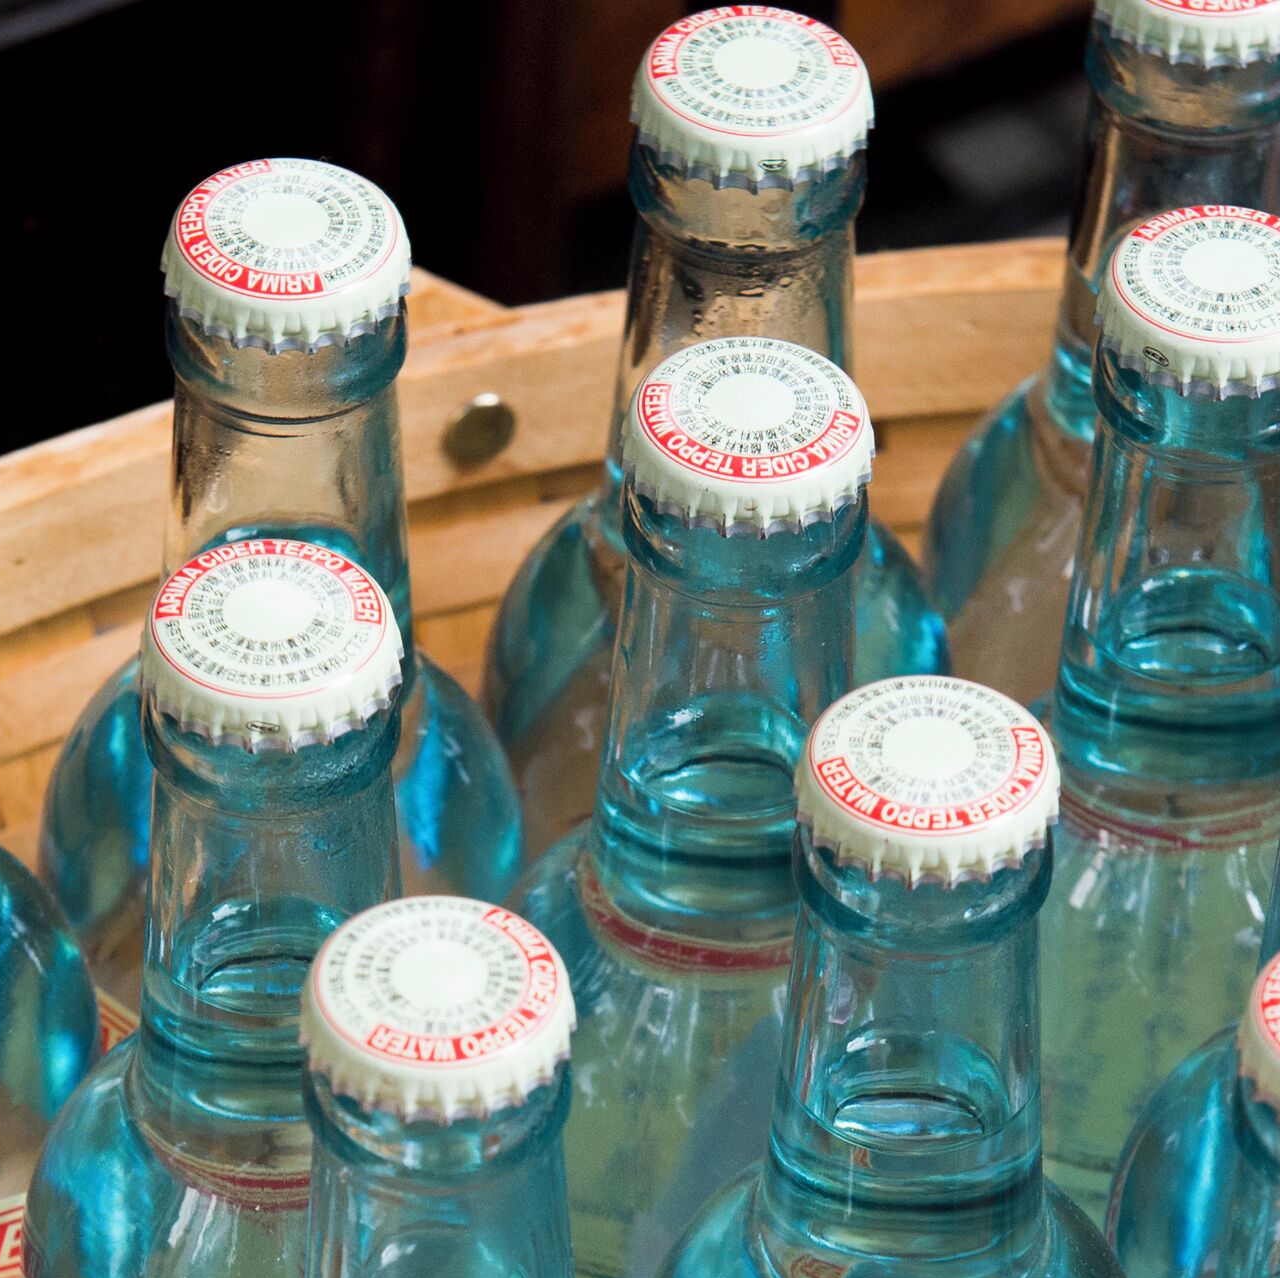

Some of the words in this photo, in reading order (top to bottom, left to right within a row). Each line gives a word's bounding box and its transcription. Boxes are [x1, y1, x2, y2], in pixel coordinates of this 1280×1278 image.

[655, 34, 683, 75] ARIMA
[677, 7, 735, 32] CIDER
[740, 5, 808, 25] TEPPO
[809, 19, 857, 67] WATER
[206, 160, 269, 193] WATER
[181, 192, 210, 242] TEPPO
[1140, 208, 1201, 240] ARIMA
[1204, 205, 1270, 223] CIDER
[190, 241, 243, 282] CIDER
[248, 272, 318, 294] ARIMA
[644, 384, 677, 432] WATER
[667, 434, 734, 475] TEPPO
[813, 411, 857, 460] ARIMA
[743, 452, 810, 476] CIDER
[158, 568, 202, 616] ARIMA
[198, 541, 266, 567] CIDER
[272, 541, 345, 570] TEPPO
[340, 566, 380, 622] WATER
[1014, 728, 1043, 778] ARIMA
[819, 758, 881, 813] WATER
[969, 783, 1027, 824] CIDER
[880, 801, 964, 829] TEPPO
[489, 910, 547, 959] ARIMA
[530, 960, 556, 1018] CIDER
[370, 1026, 456, 1061] WATER
